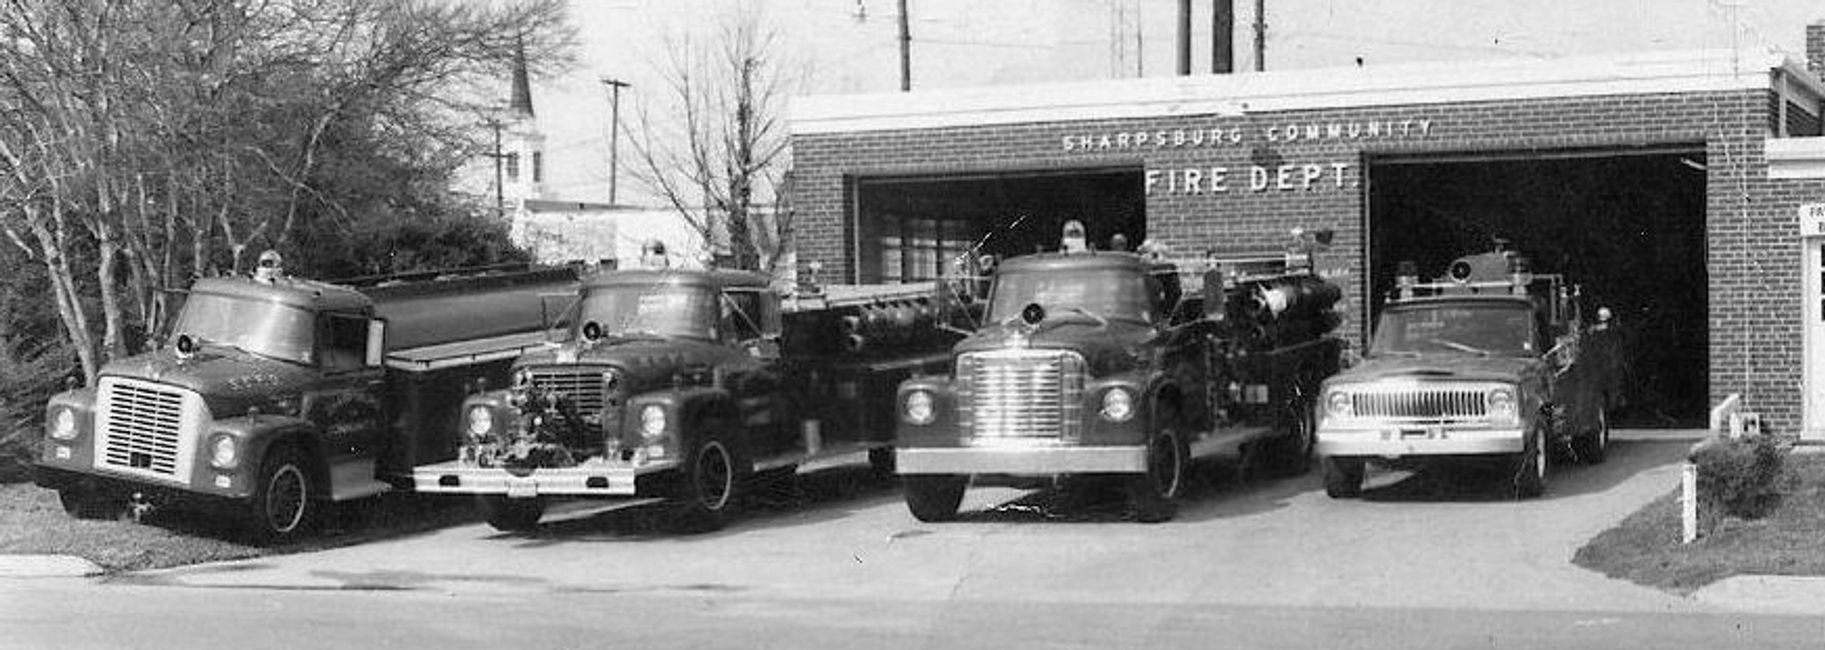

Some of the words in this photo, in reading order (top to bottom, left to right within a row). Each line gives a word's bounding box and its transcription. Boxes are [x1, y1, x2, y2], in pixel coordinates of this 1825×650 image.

[1062, 128, 1242, 150] SHARPSBURG
[1268, 119, 1434, 142] COMMUNITY
[1146, 167, 1228, 195] FIRE
[1250, 162, 1358, 192] DEPT.
